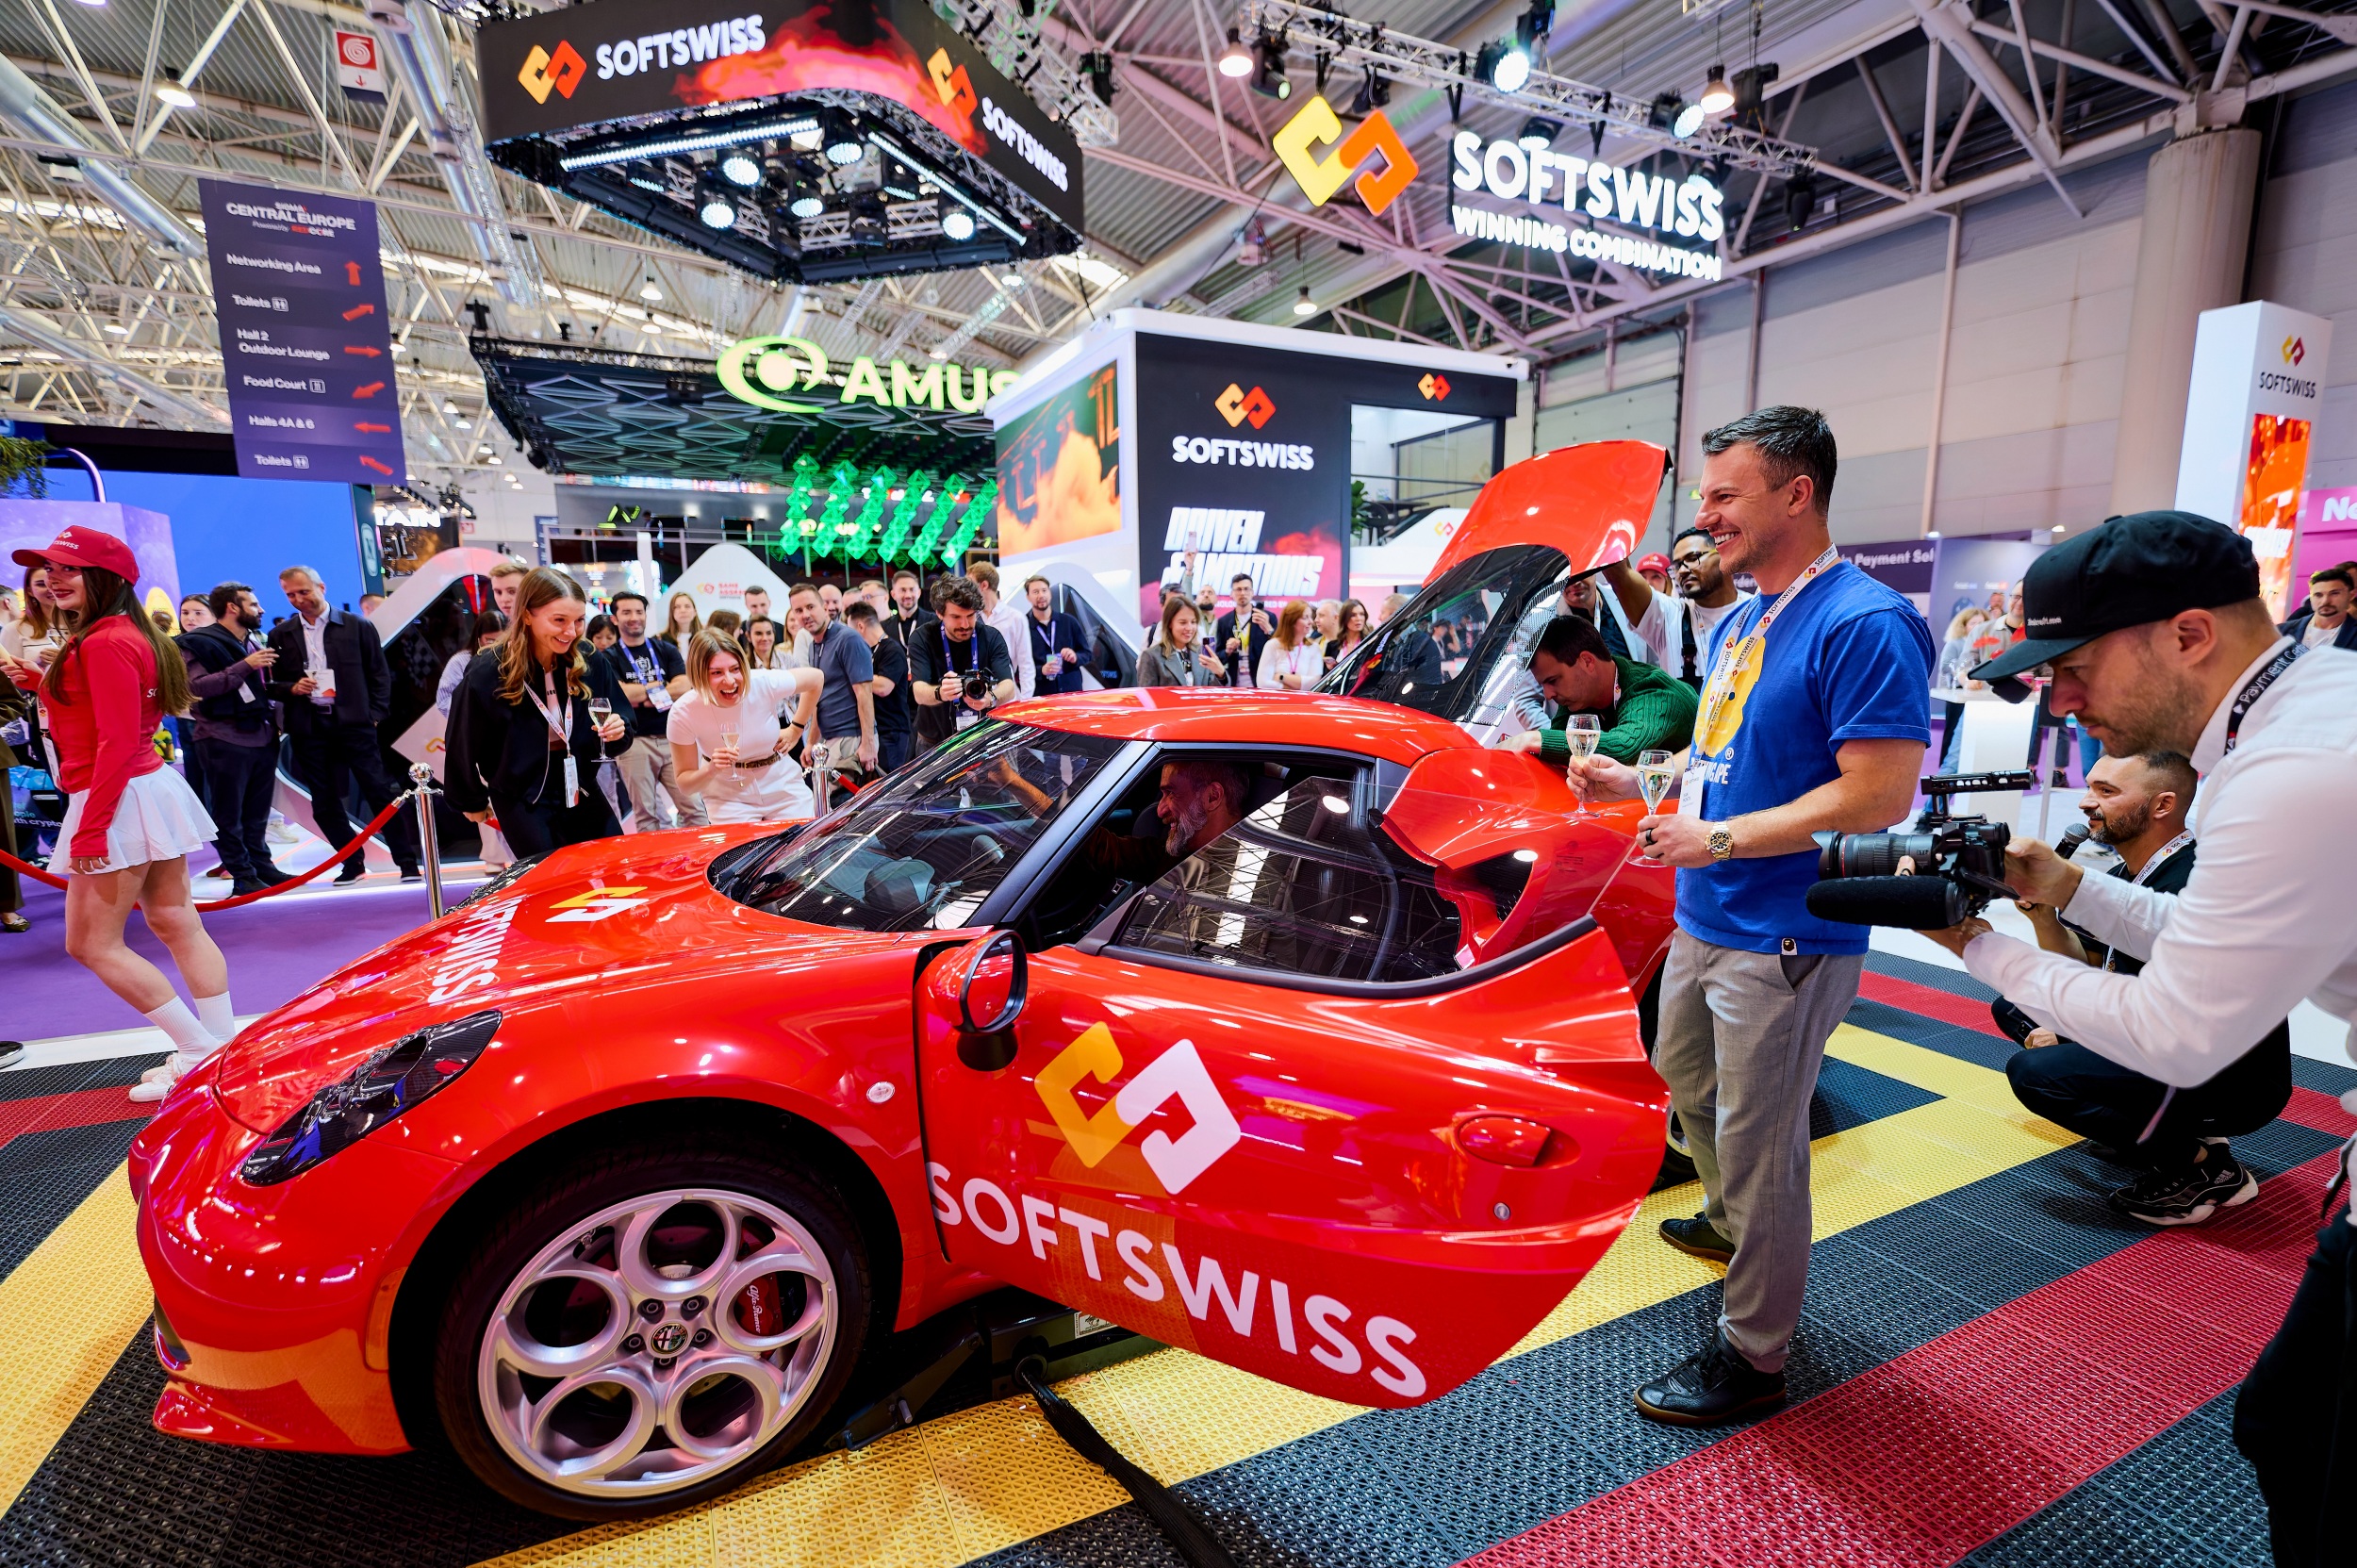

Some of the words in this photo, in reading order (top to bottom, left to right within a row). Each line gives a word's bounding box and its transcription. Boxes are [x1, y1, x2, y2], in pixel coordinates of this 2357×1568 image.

[596, 14, 766, 80] SOFTSWISS
[981, 96, 1068, 192] SOFTSWISS
[1452, 131, 1724, 242] SOFTSWISS
[225, 202, 297, 223] CENTRAL
[297, 212, 356, 231] EUROPE
[1452, 205, 1568, 253] WINNING
[1570, 228, 1722, 282] COMBINATION
[226, 253, 293, 273] Networking
[294, 260, 322, 274] Area
[232, 293, 272, 309] Toilets
[237, 328, 261, 341] Hall
[260, 332, 270, 341] 2
[238, 342, 288, 357] Outdoor
[288, 346, 331, 361] Lounge
[243, 374, 274, 388] Food
[273, 378, 307, 391] Court
[2259, 371, 2316, 400] SOFTSWISS
[249, 415, 278, 427] Halls
[278, 417, 296, 429] 4A
[295, 419, 305, 429] &
[305, 419, 316, 430] 6
[255, 454, 292, 468] Toilets
[1172, 436, 1314, 470] SOFTSWISS
[1163, 506, 1265, 553] DRIVEN
[1854, 551, 1910, 569] Payment
[1912, 547, 1935, 564] Sol
[1769, 586, 1796, 615] SOFTSWISS
[1718, 651, 1732, 681] SOFTSWISS
[1736, 636, 1755, 668] SOFTSWISS
[2239, 656, 2292, 702] Payment
[2214, 1172, 2235, 1184] adidas
[926, 1161, 1427, 1398] SOFTSWISS
